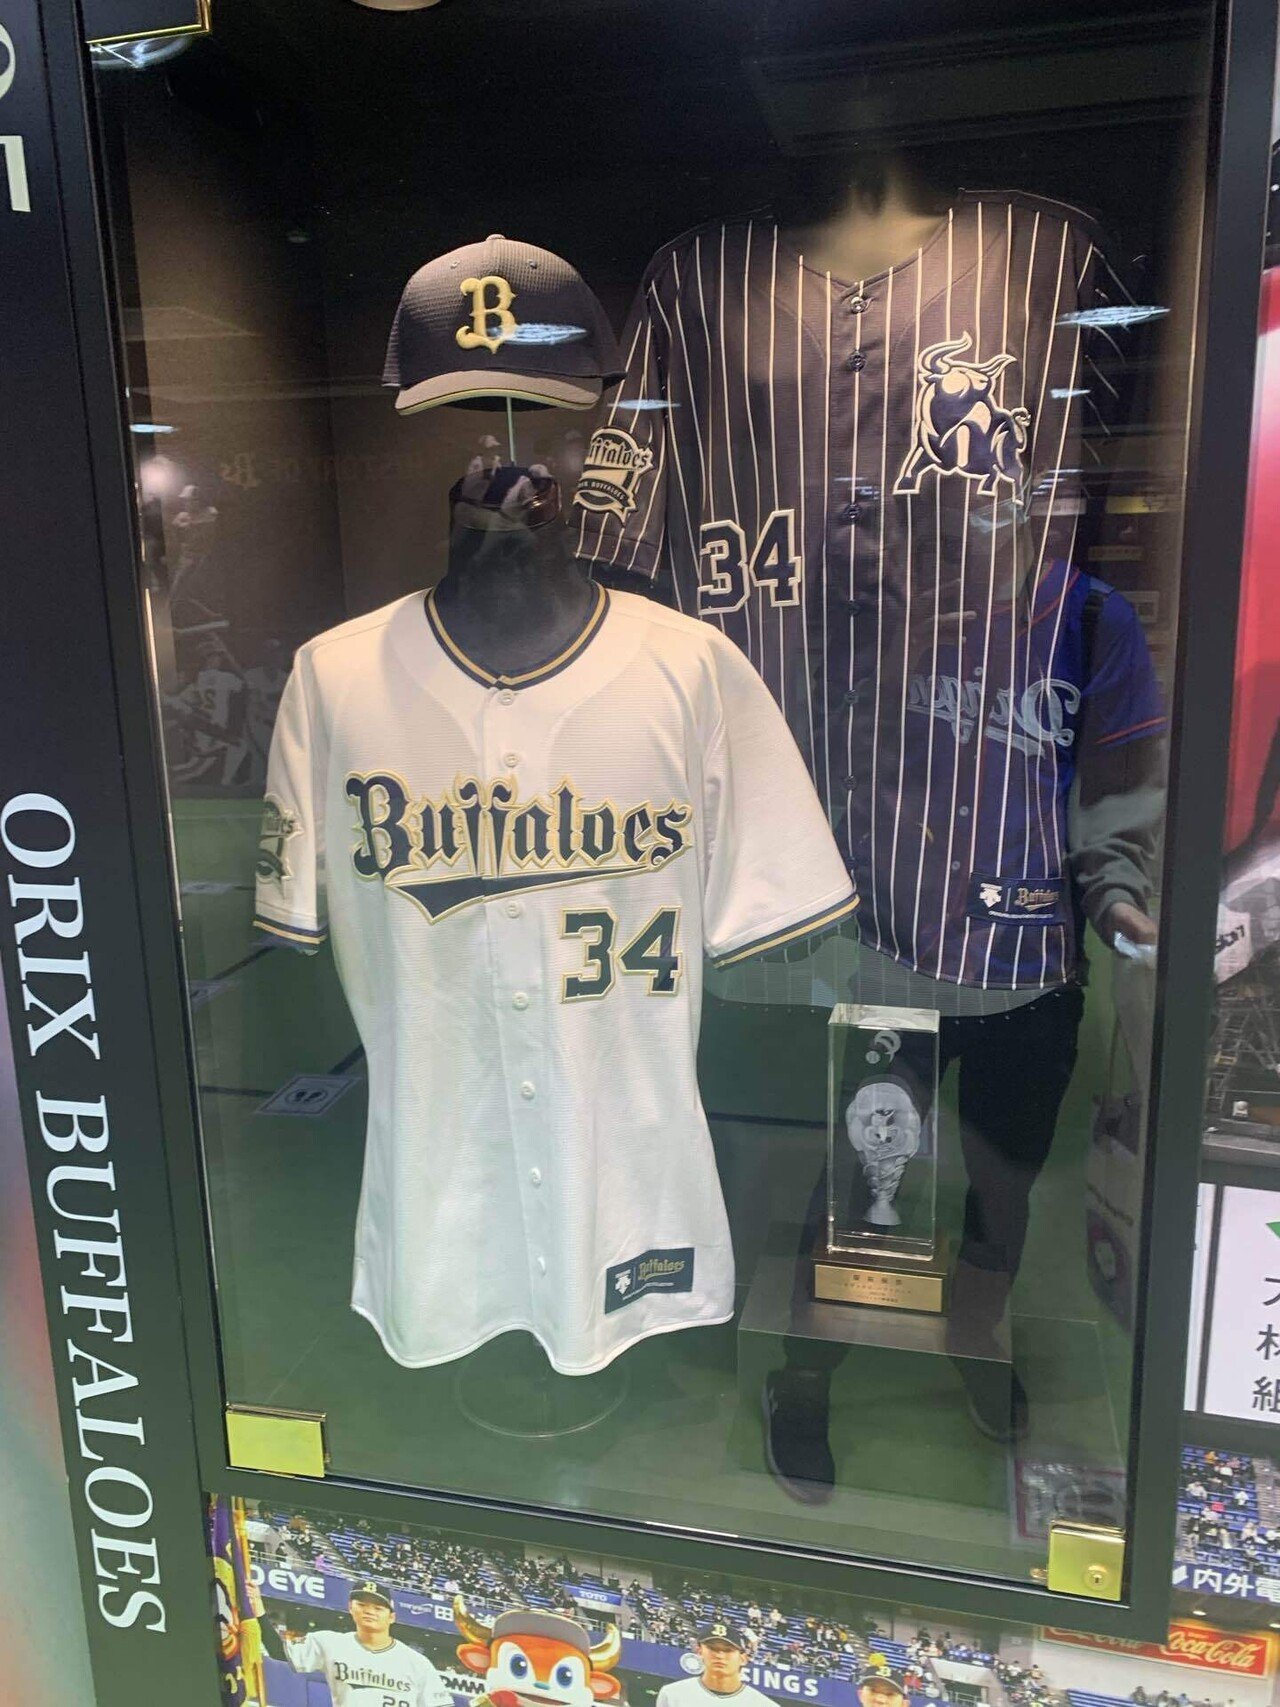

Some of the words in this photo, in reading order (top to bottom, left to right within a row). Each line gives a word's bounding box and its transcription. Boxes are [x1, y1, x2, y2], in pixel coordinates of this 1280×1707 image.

[456, 275, 516, 354] B
[698, 509, 802, 615] 34
[345, 769, 692, 882] Buffaloes
[1, 793, 101, 1060] ORIX
[560, 906, 684, 1004] 34
[35, 1089, 167, 1636] BUFFALOES
[579, 1589, 609, 1602] TOTO
[334, 1661, 411, 1693] Buffaloes
